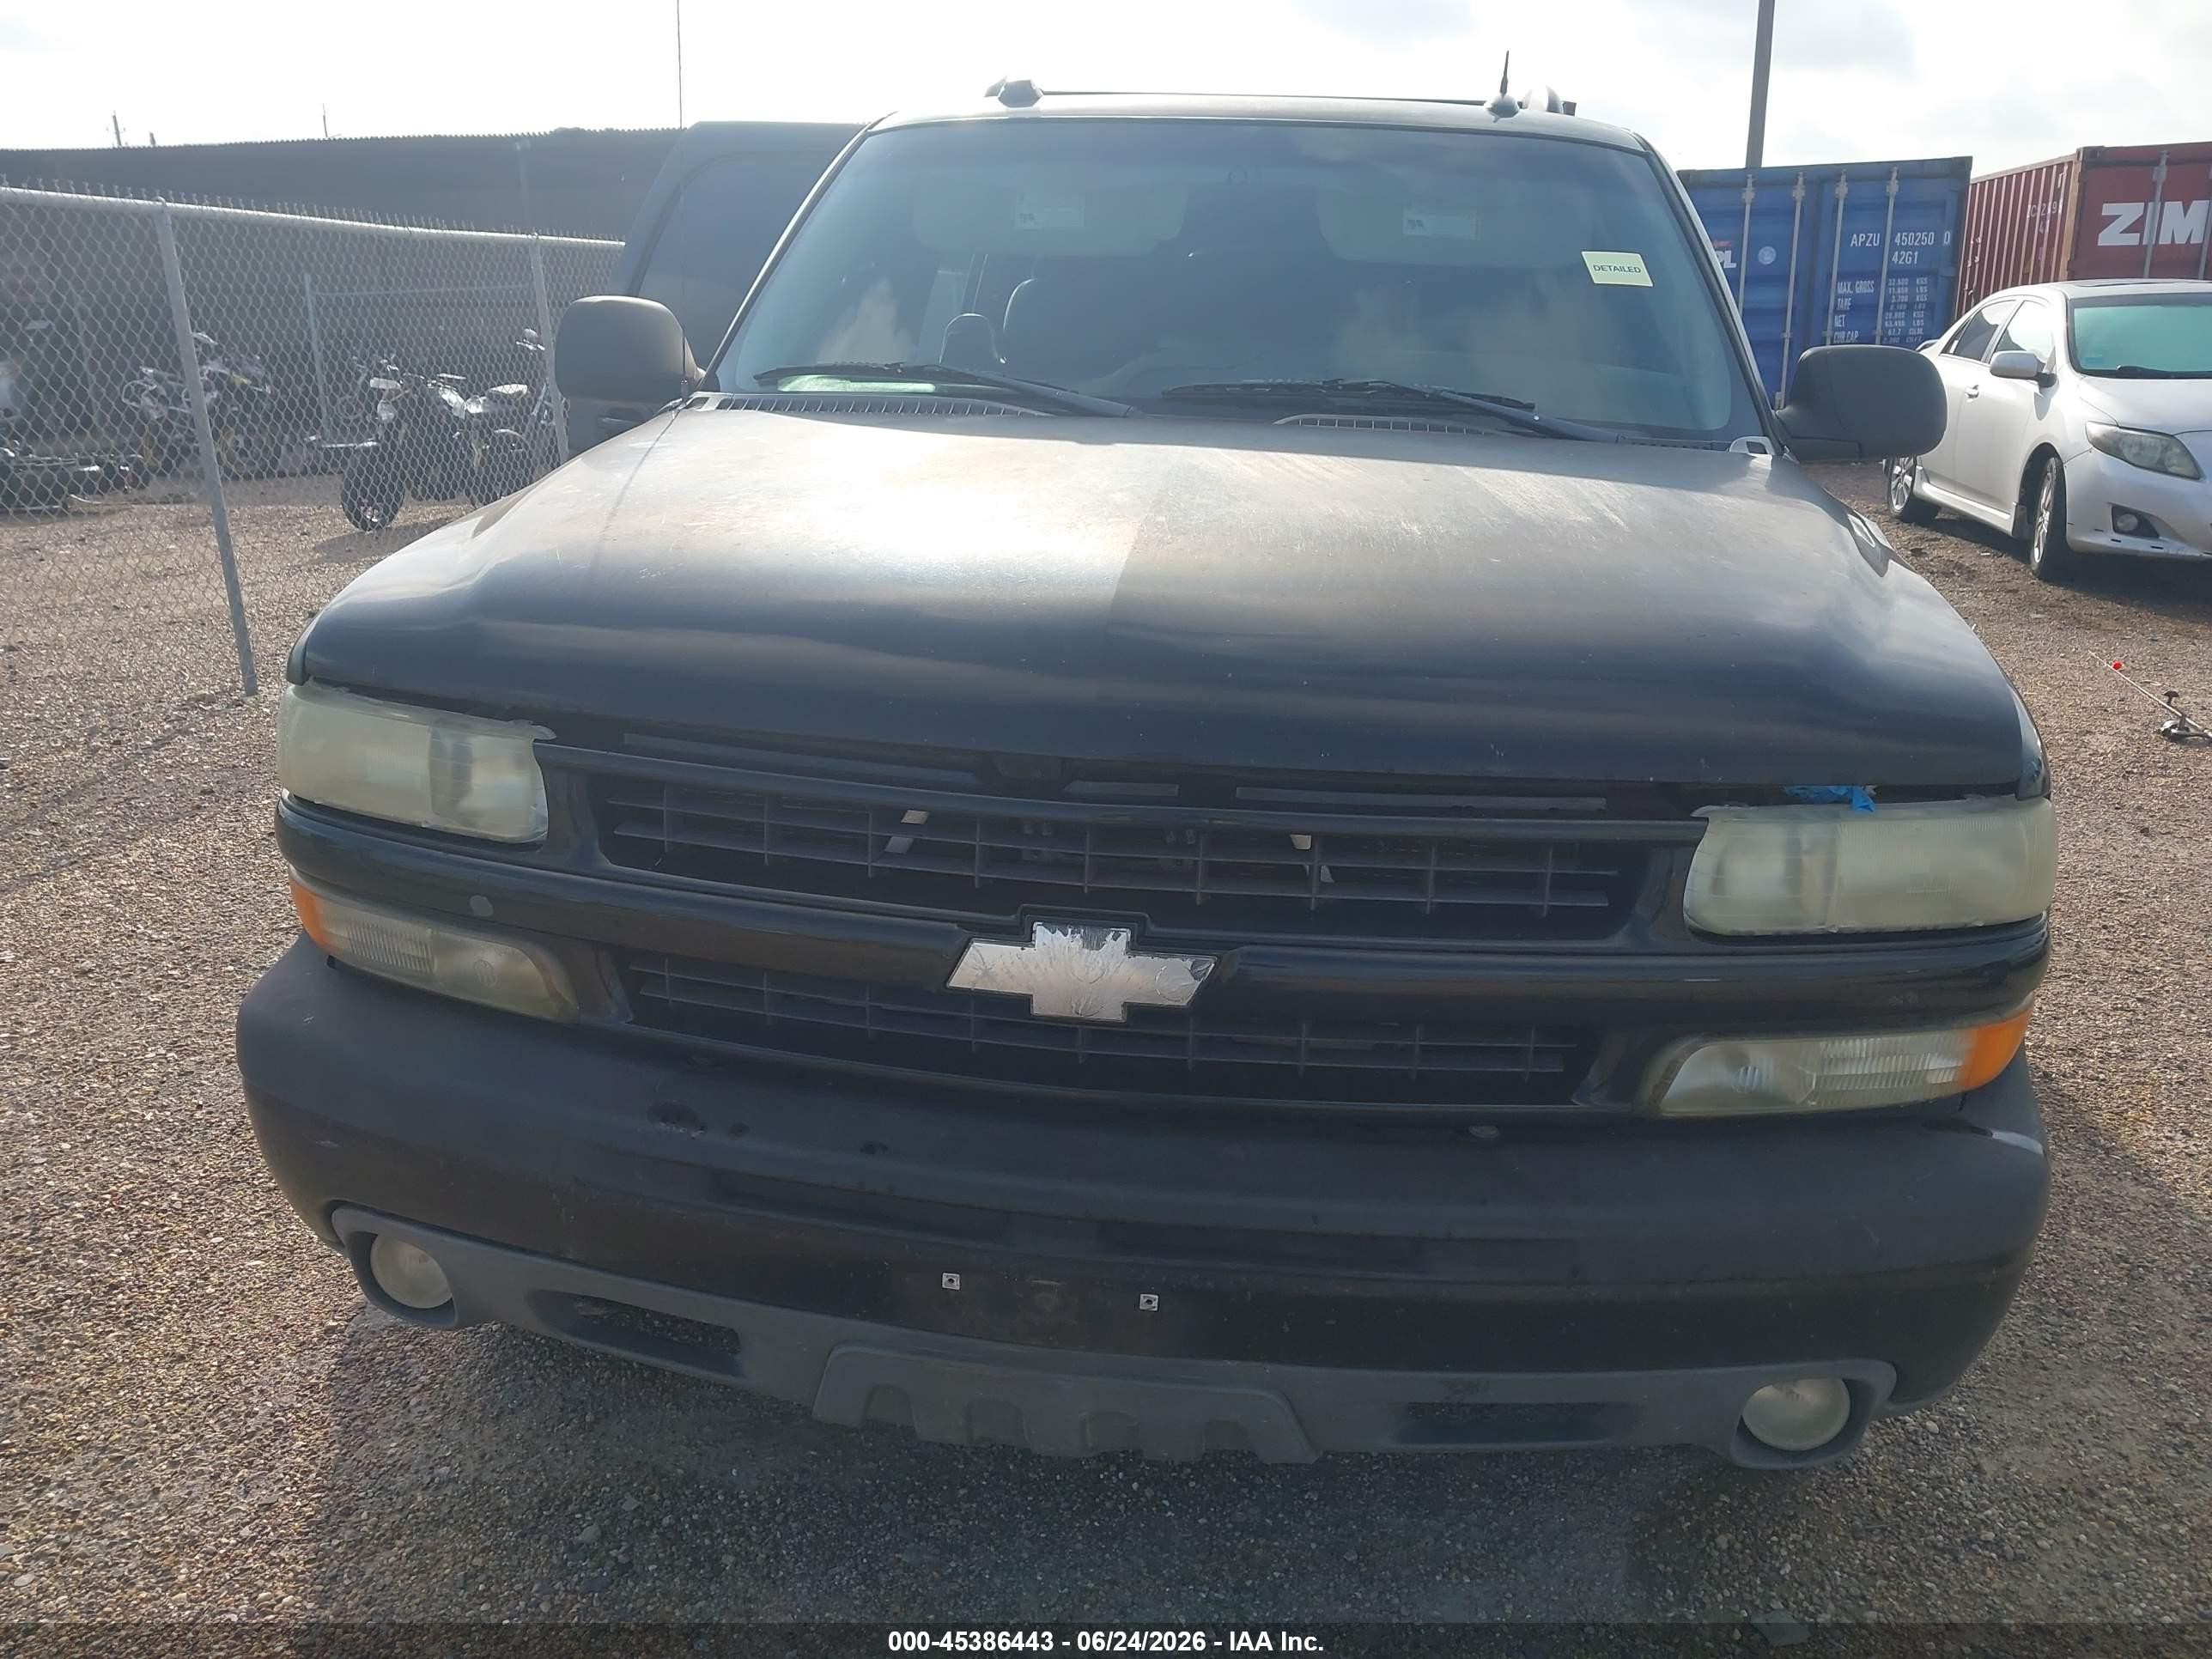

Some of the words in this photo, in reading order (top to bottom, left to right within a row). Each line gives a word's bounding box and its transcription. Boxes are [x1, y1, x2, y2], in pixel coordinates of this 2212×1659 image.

[2098, 200, 2209, 246] ZIM
[1850, 233, 1881, 247] APZU
[1894, 231, 1935, 246] 450250
[1892, 251, 1919, 264] 42G1
[1593, 264, 1641, 273] DETAILED
